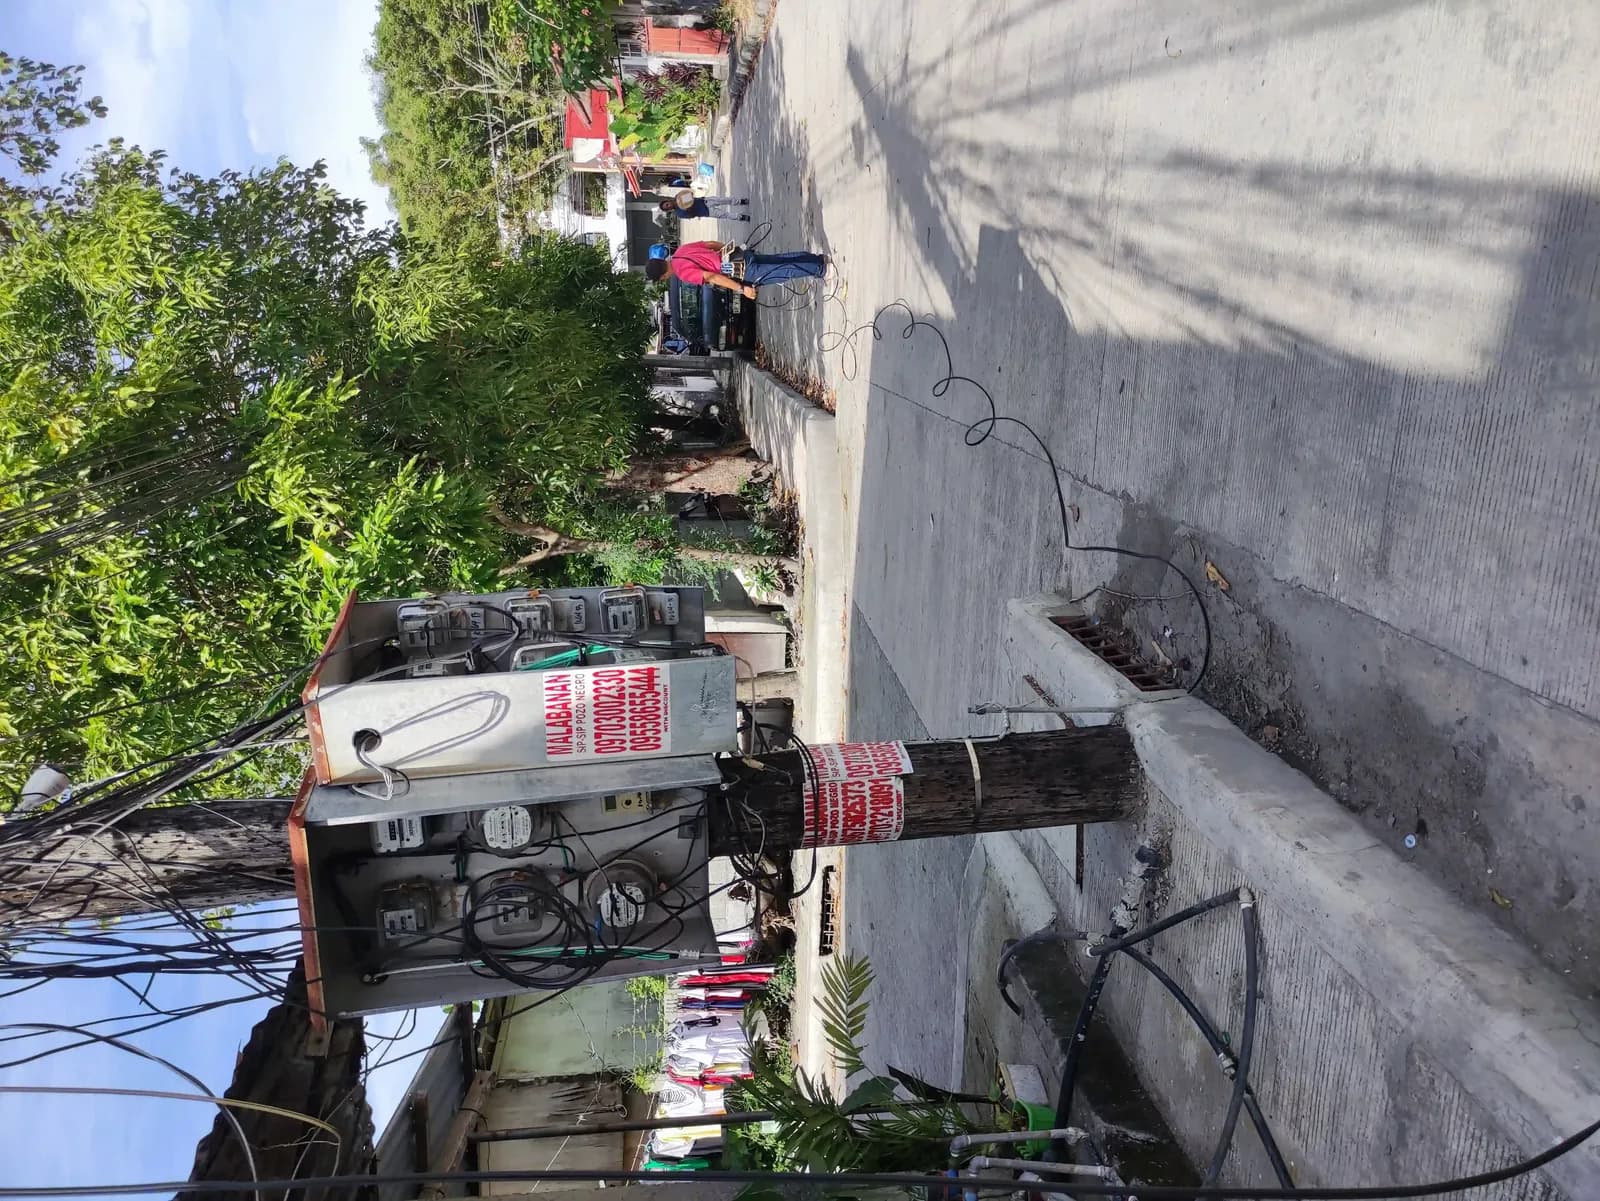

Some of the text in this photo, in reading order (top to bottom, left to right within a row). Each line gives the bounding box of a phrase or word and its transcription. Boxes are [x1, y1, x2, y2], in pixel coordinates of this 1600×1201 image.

[544, 674, 573, 756] MALABANAN
[574, 673, 587, 753] SIP-SIP POZO NEGRO
[591, 669, 627, 754] 09703002330
[628, 667, 662, 751] 09558655444
[829, 783, 839, 808] NEGRO
[830, 810, 839, 829] POZO
